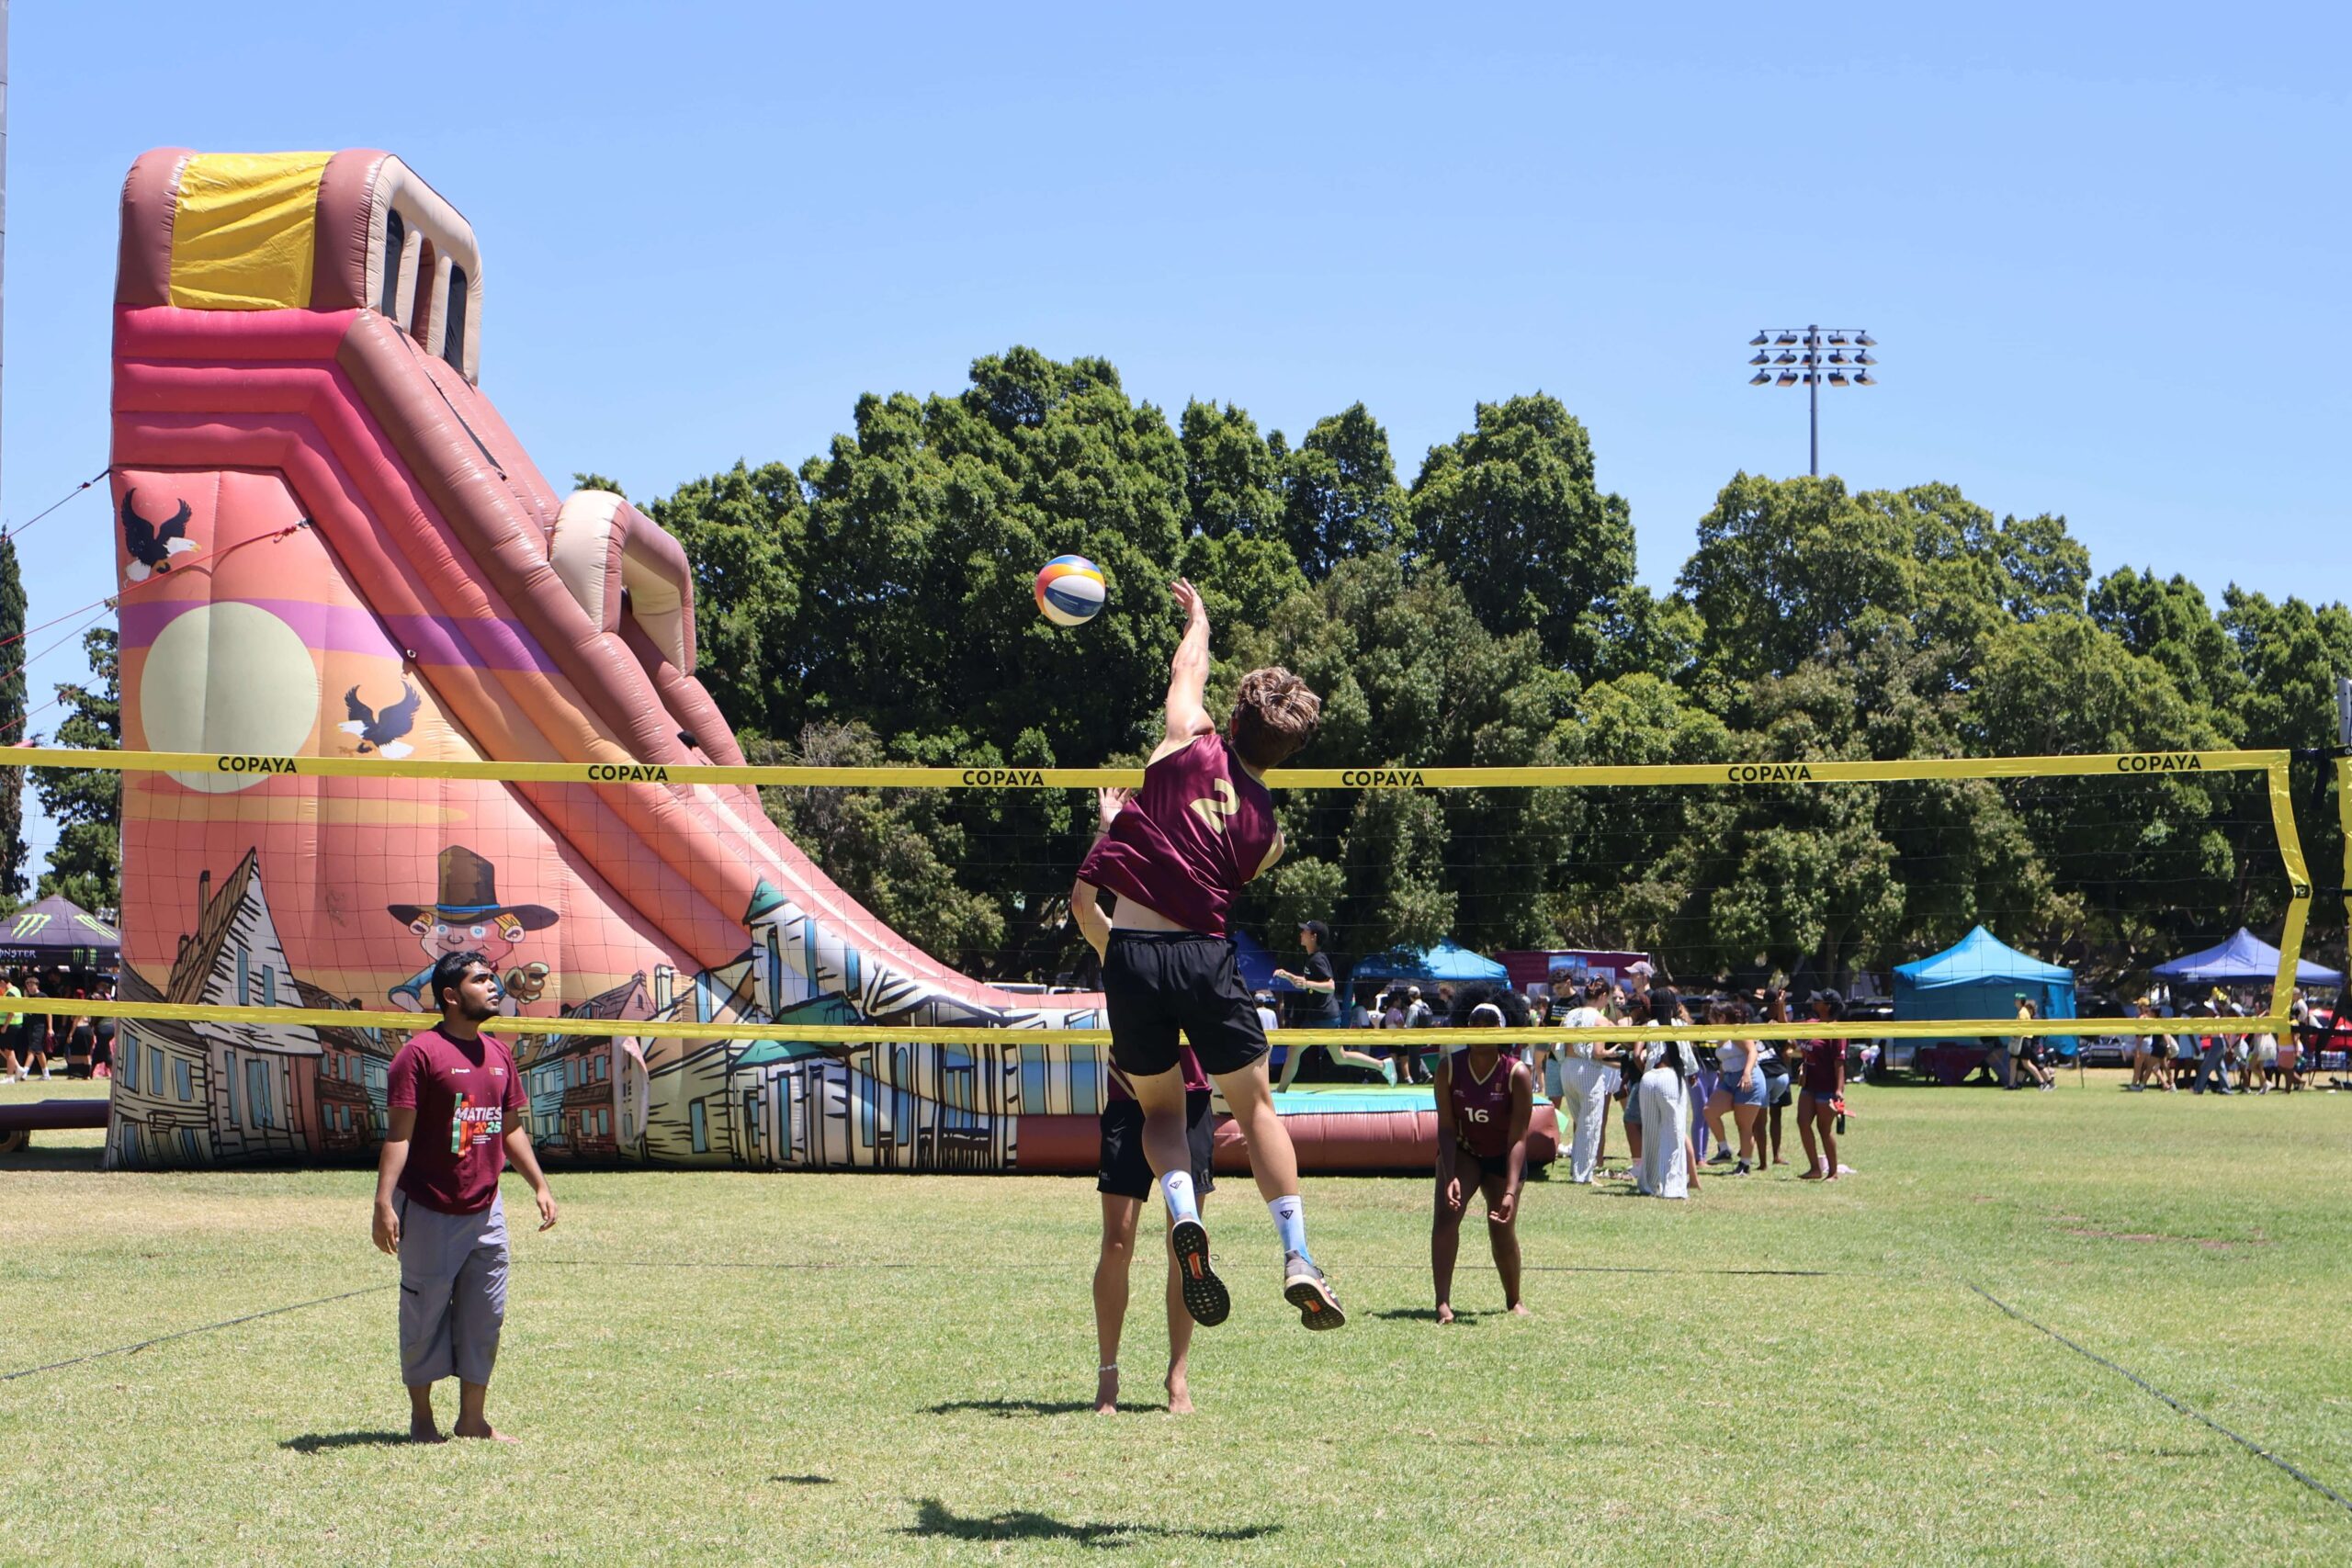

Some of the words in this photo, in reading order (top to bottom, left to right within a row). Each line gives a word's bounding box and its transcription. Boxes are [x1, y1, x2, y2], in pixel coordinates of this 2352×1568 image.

[218, 756, 297, 773] COPAYA
[2117, 754, 2201, 773] COPAYA
[587, 764, 668, 782] COPAYA
[962, 770, 1045, 786] COPAYA
[1341, 771, 1425, 786] COPAYA
[1727, 764, 1812, 783] COPAYA
[454, 1106, 503, 1122] MATIES
[1464, 1107, 1489, 1123] 16
[472, 1121, 503, 1134] 2025
